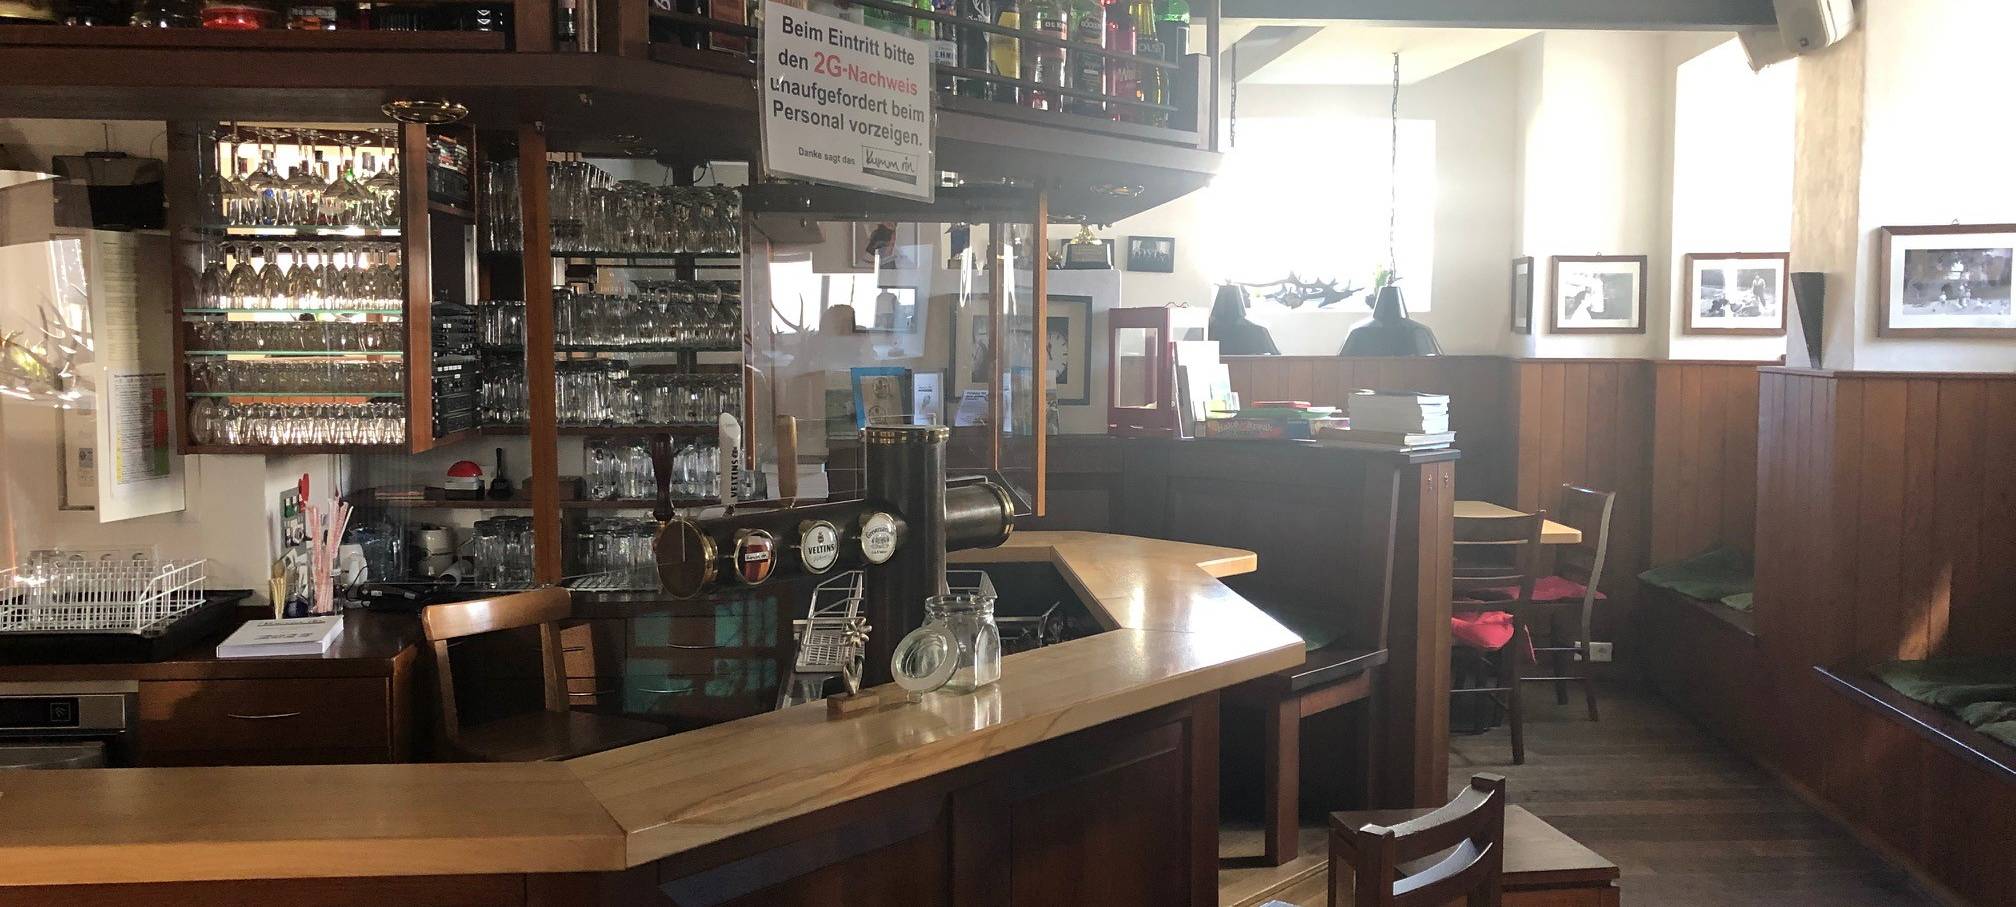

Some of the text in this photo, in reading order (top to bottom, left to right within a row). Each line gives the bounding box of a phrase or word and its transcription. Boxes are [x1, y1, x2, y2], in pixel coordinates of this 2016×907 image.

[782, 16, 915, 65] Beim Eintritt bitte
[778, 49, 918, 96] den 2G-Nachweis
[770, 77, 925, 123] unaufgefordert beim
[773, 100, 923, 146] Personal vorzeigen.
[798, 147, 855, 165] Danke sagt das
[731, 459, 739, 498] VELTINS
[808, 543, 835, 555] VELTINS
